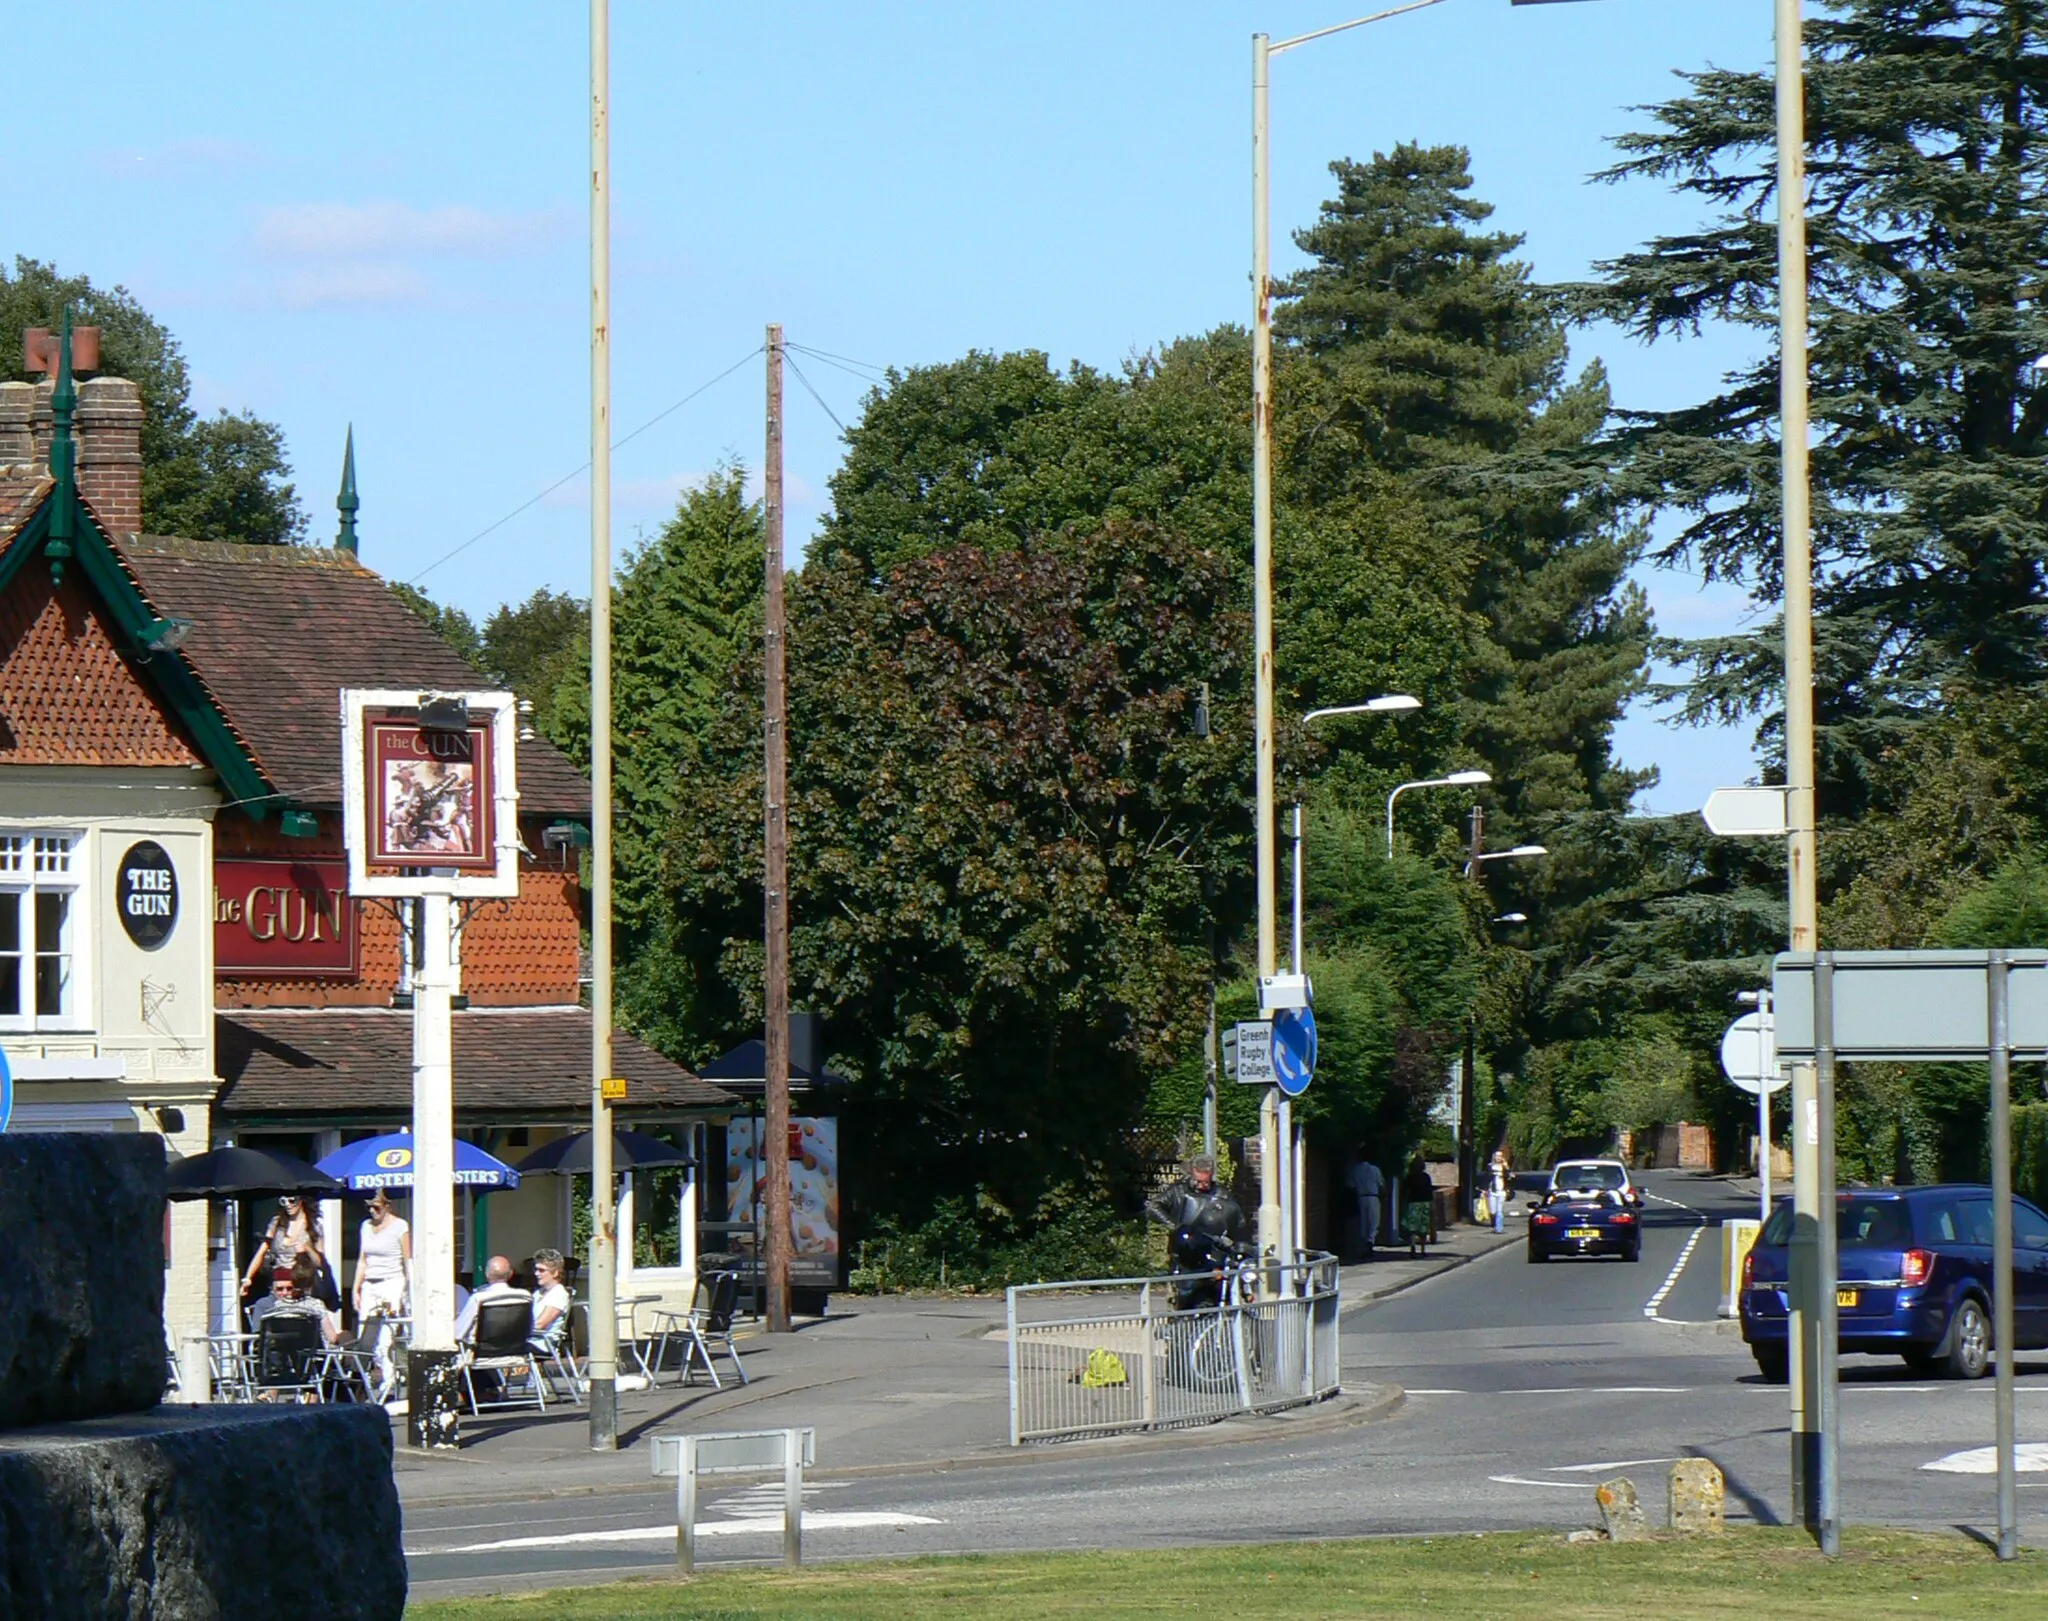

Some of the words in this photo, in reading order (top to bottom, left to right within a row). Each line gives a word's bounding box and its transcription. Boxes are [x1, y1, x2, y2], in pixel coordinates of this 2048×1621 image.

[386, 734, 409, 749] the
[411, 734, 472, 756] GUN
[127, 869, 171, 891] THE
[127, 894, 171, 916] GUN
[214, 885, 240, 922] he
[245, 886, 344, 942] GUN
[1240, 1028, 1269, 1042] Greenh
[1240, 1046, 1266, 1060] Rugby
[1240, 1063, 1271, 1077] College
[355, 1172, 414, 1188] FOSTER
